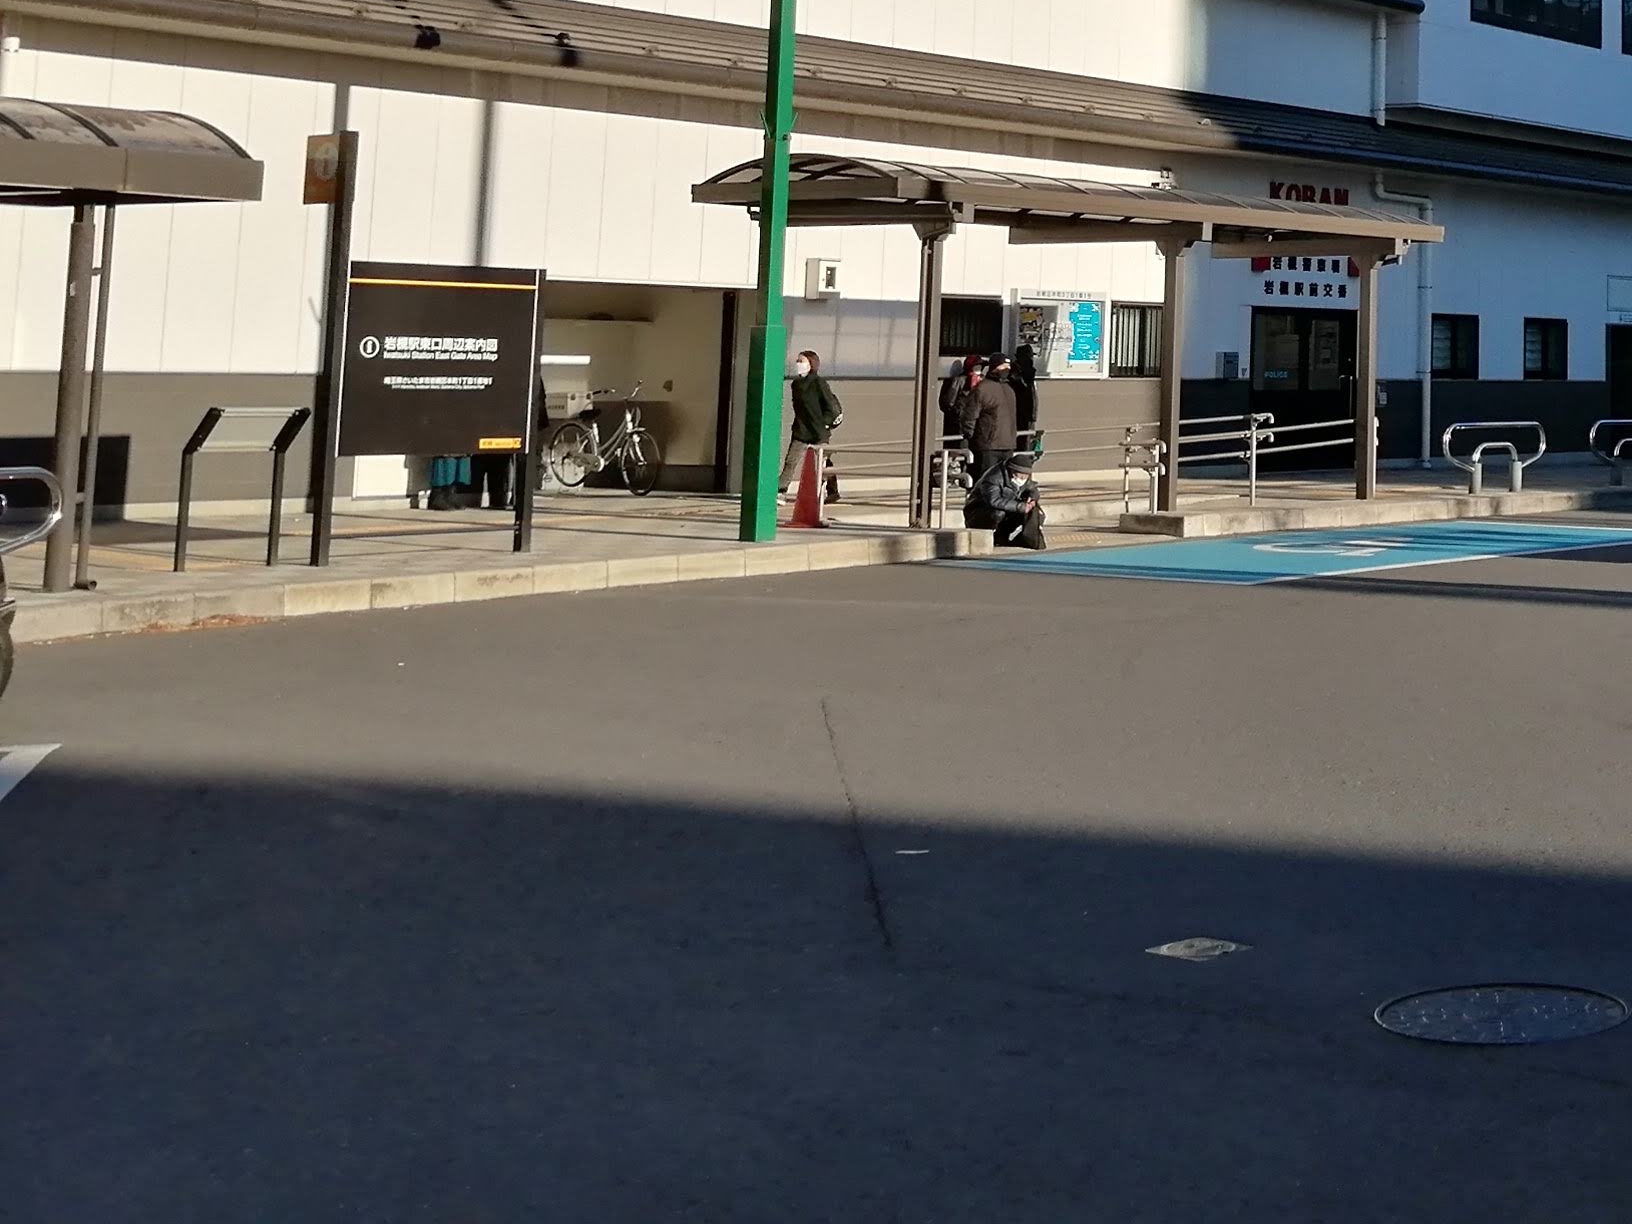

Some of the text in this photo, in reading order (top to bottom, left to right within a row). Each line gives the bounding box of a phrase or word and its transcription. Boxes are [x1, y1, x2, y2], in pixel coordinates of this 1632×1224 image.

[1264, 280, 1347, 299] 岩槻駅前交番
[412, 351, 435, 360] Station
[435, 352, 450, 360] East
[451, 353, 466, 361] Gate
[467, 353, 482, 361] Area
[482, 353, 498, 362] Map
